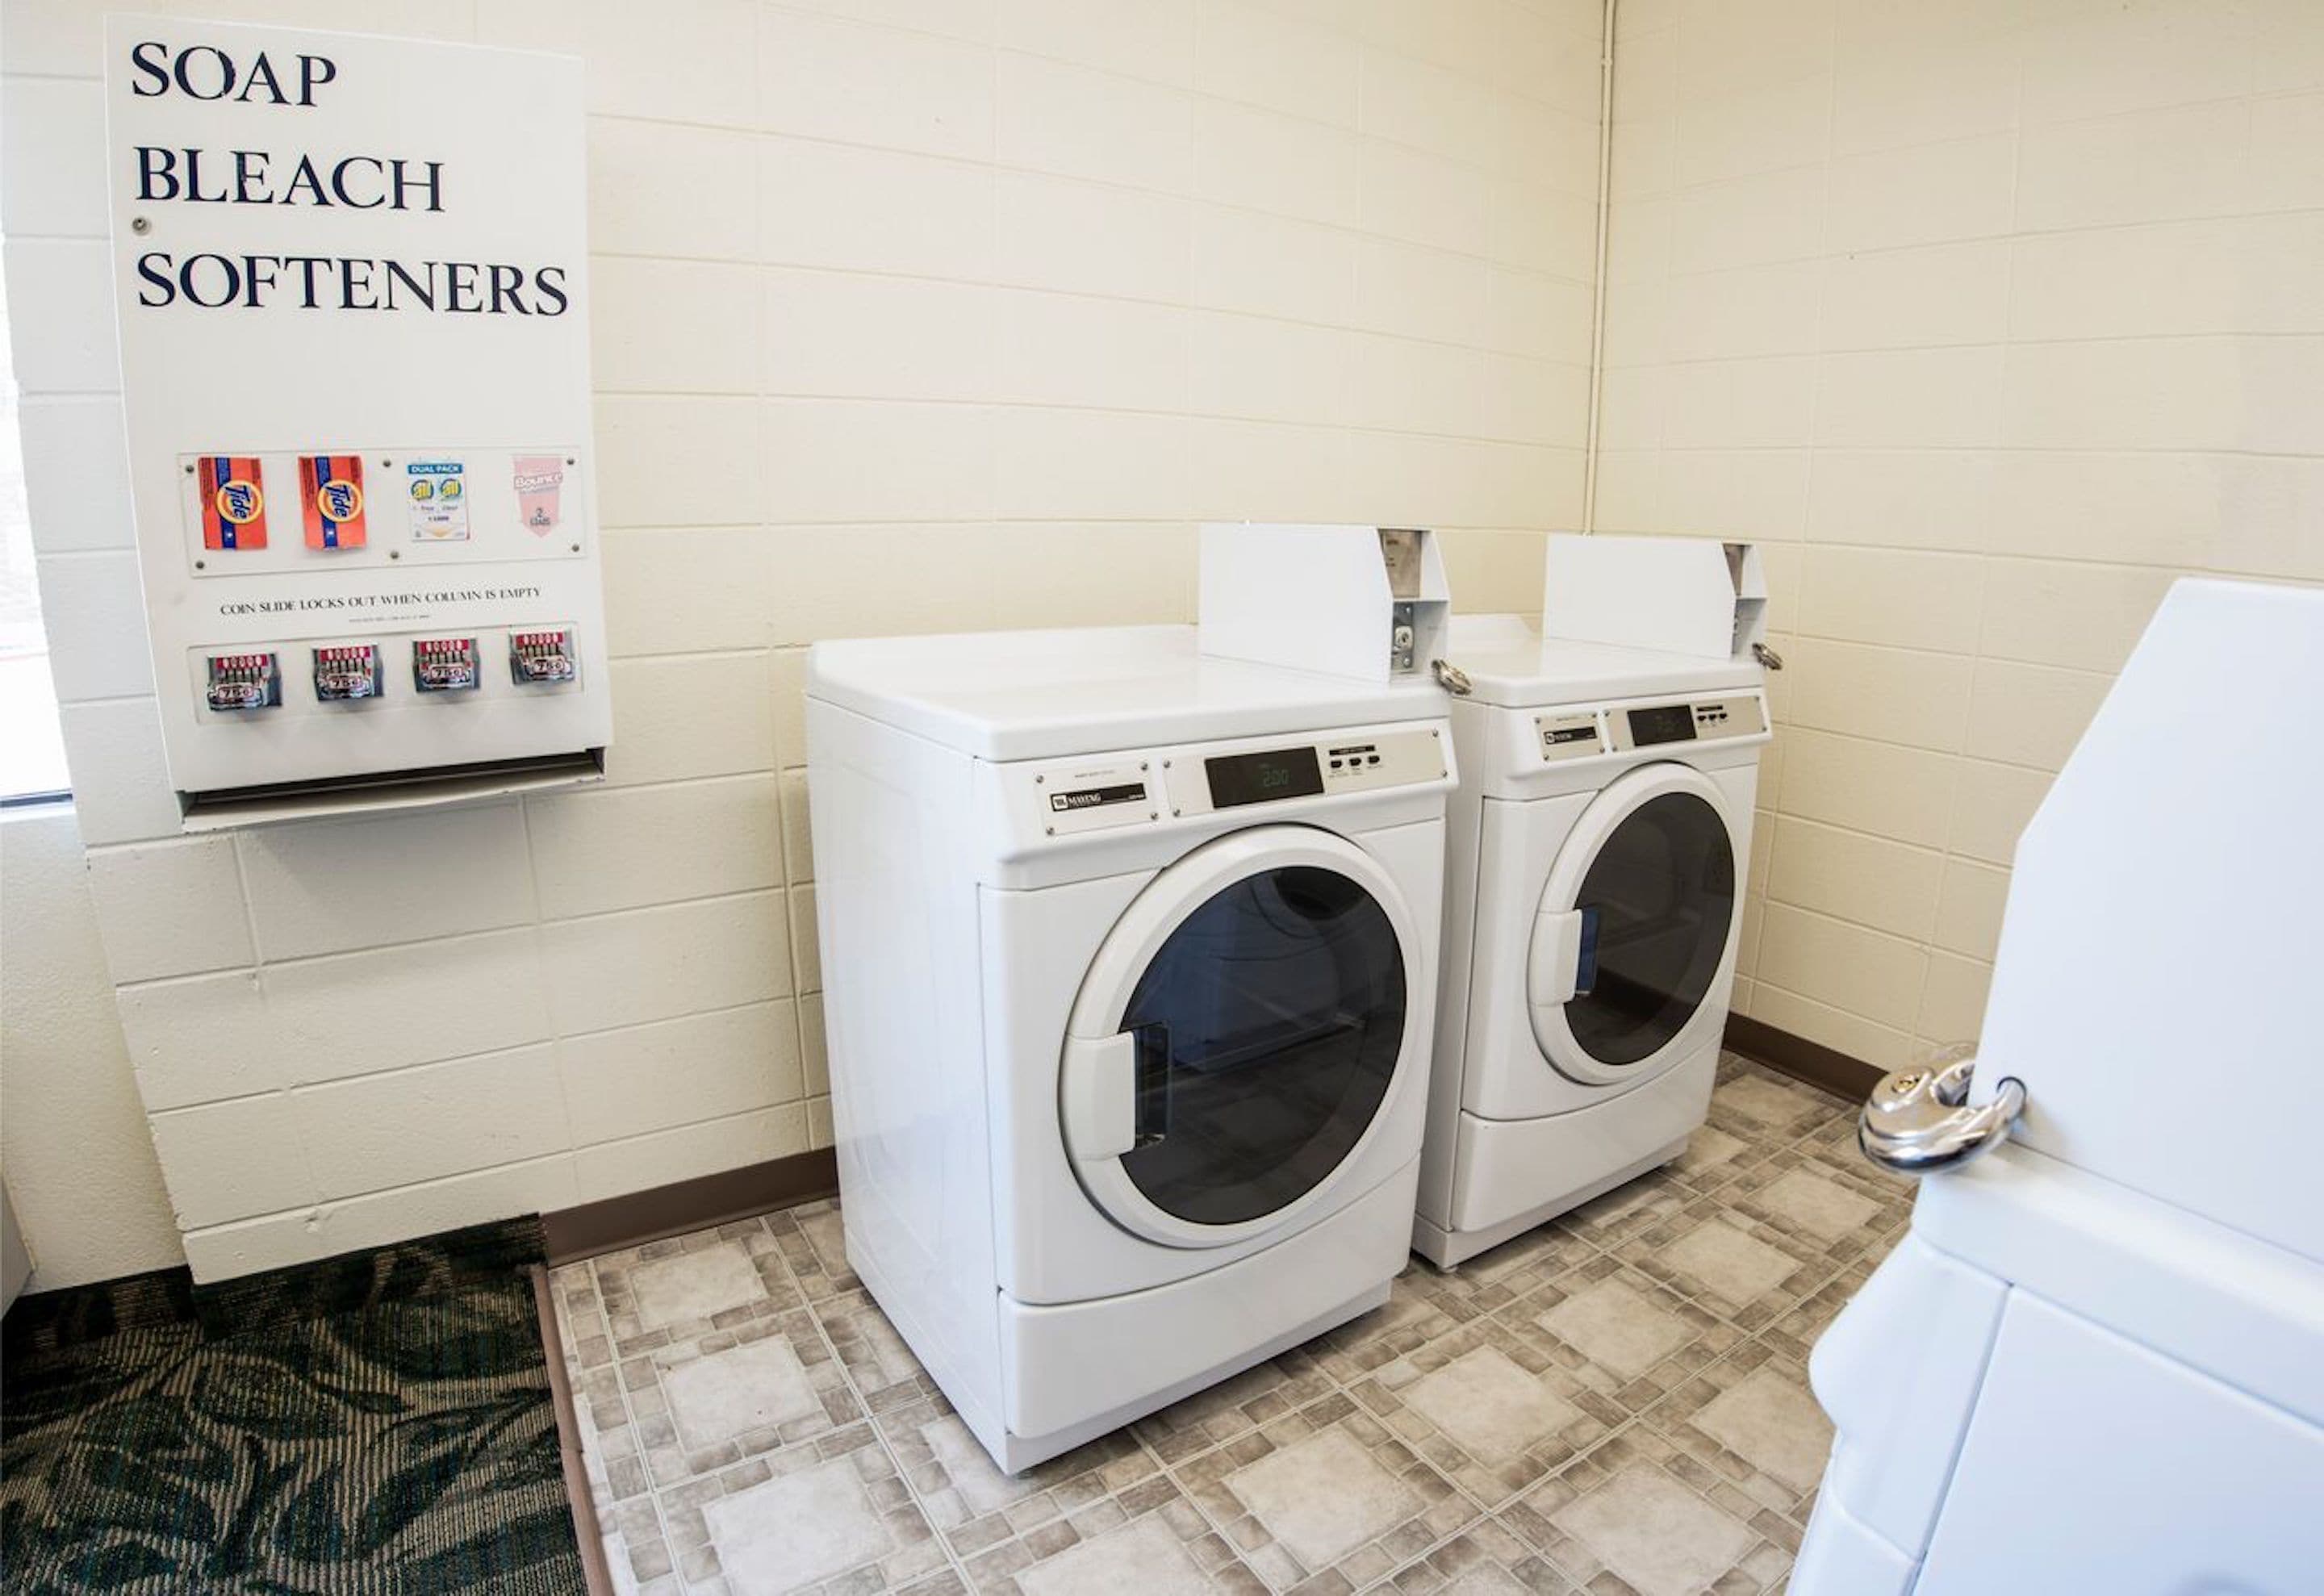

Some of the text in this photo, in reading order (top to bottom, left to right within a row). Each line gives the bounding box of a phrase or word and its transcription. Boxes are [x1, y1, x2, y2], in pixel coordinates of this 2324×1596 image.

[132, 42, 336, 107] SOAP
[133, 147, 444, 211] BLEACH
[138, 253, 567, 315] SOFTENERS
[437, 465, 460, 473] PACK
[225, 485, 251, 519] Tide
[325, 484, 351, 517] Tide
[220, 587, 541, 615] COIN SLIDE LOCKS OUT WHEN COLUMN IS EMPTY
